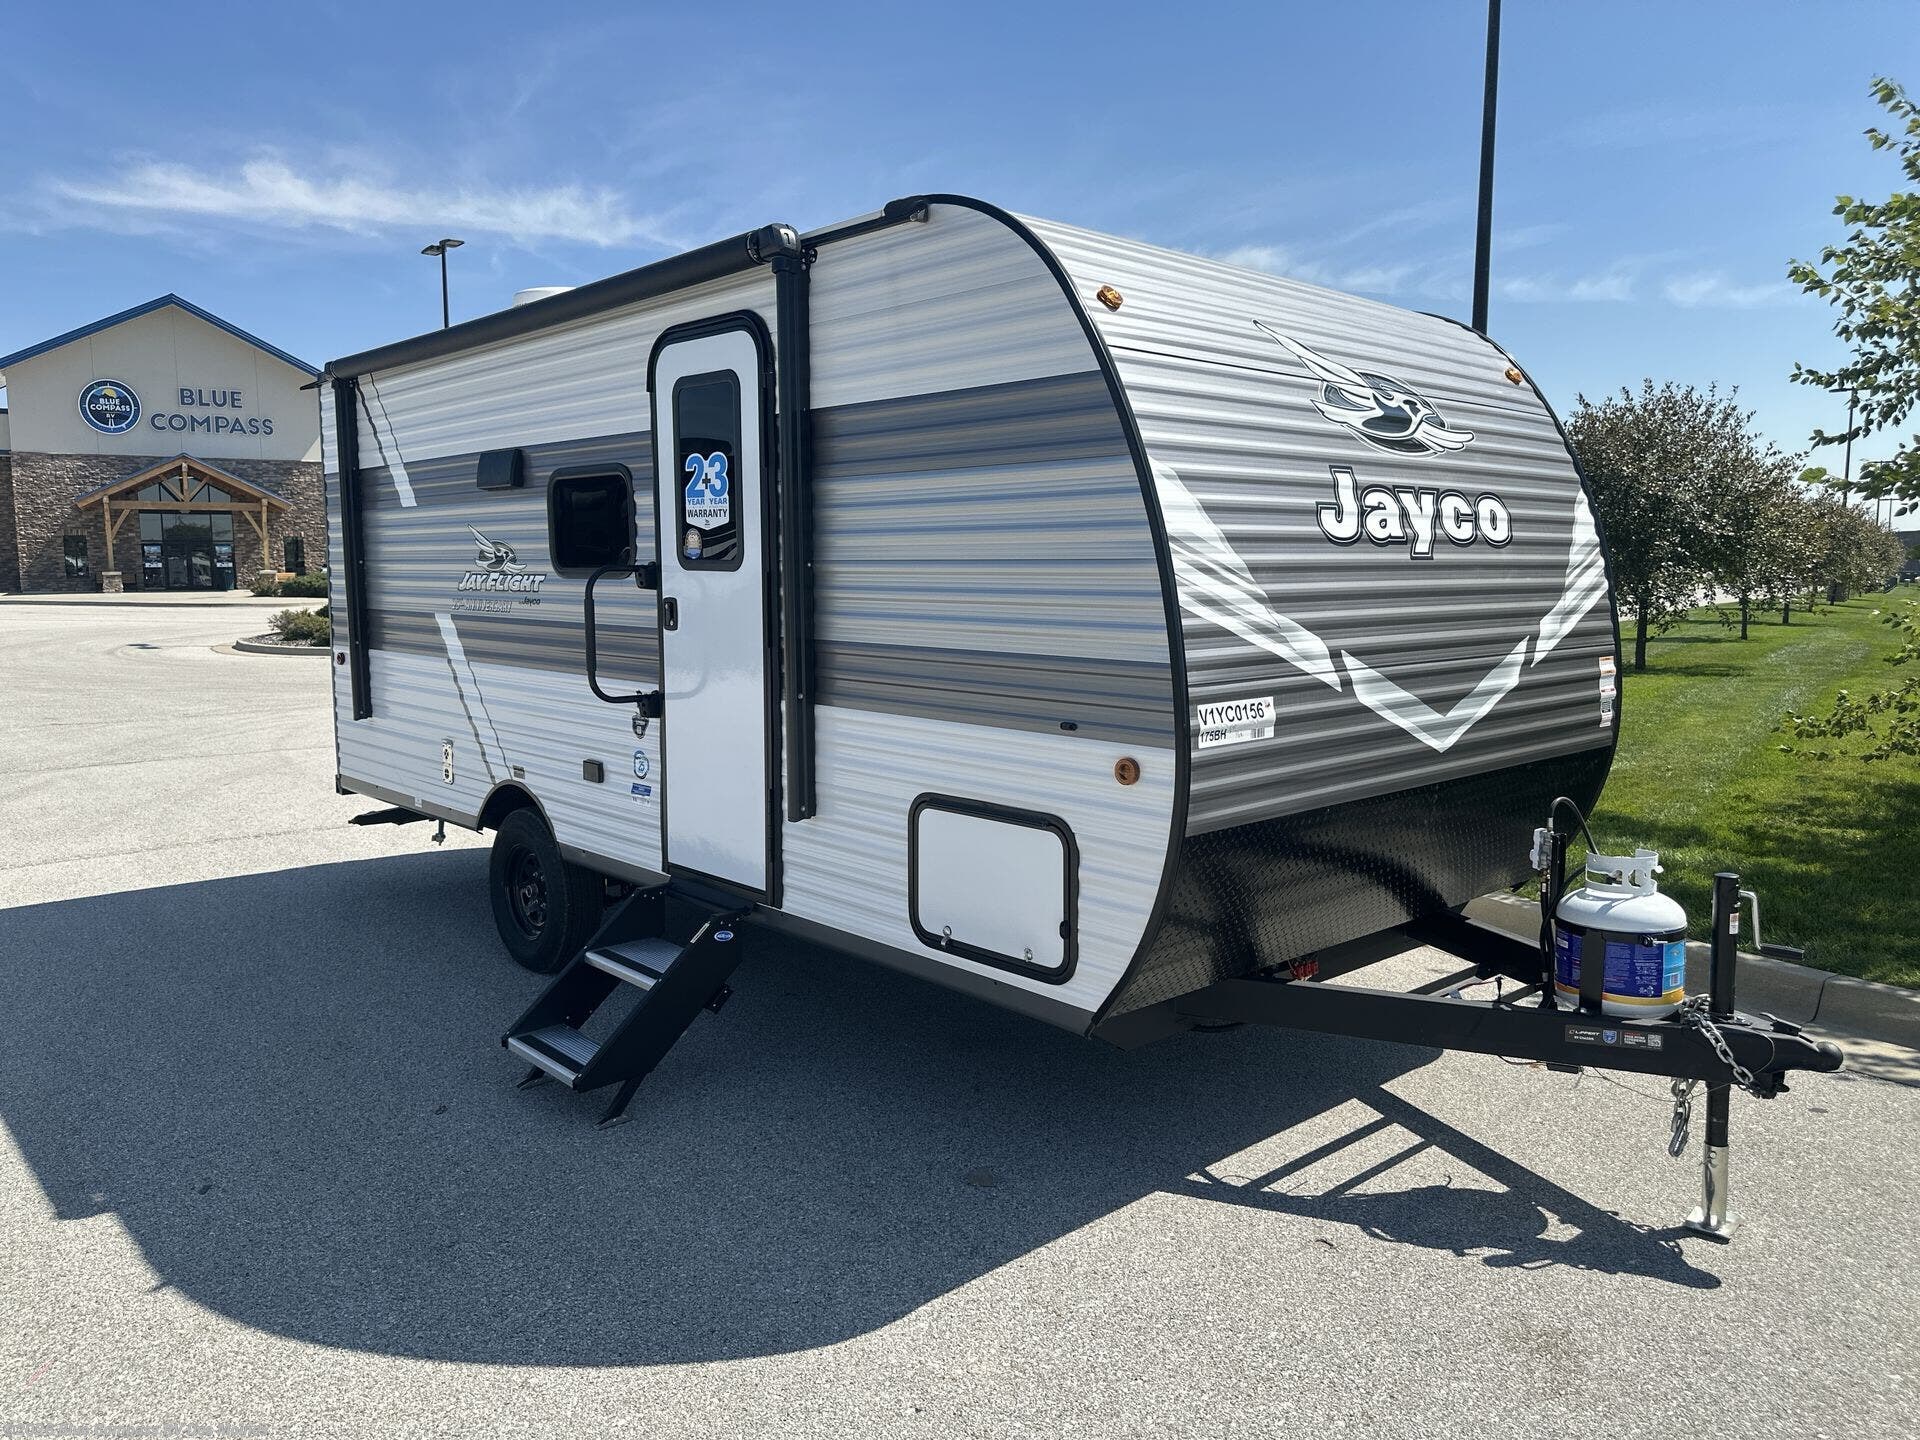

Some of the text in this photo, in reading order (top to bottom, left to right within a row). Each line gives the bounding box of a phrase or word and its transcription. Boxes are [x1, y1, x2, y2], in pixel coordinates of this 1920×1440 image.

[178, 387, 243, 409] BLUE
[90, 404, 131, 412] COMPASS
[150, 412, 274, 436] COMPASS
[687, 497, 728, 506] YEAR YEAR
[687, 508, 728, 518] WARRANTY
[1315, 464, 1513, 560] Jayco
[1199, 702, 1265, 726] V1YC0156
[1200, 729, 1227, 743] 175BH
